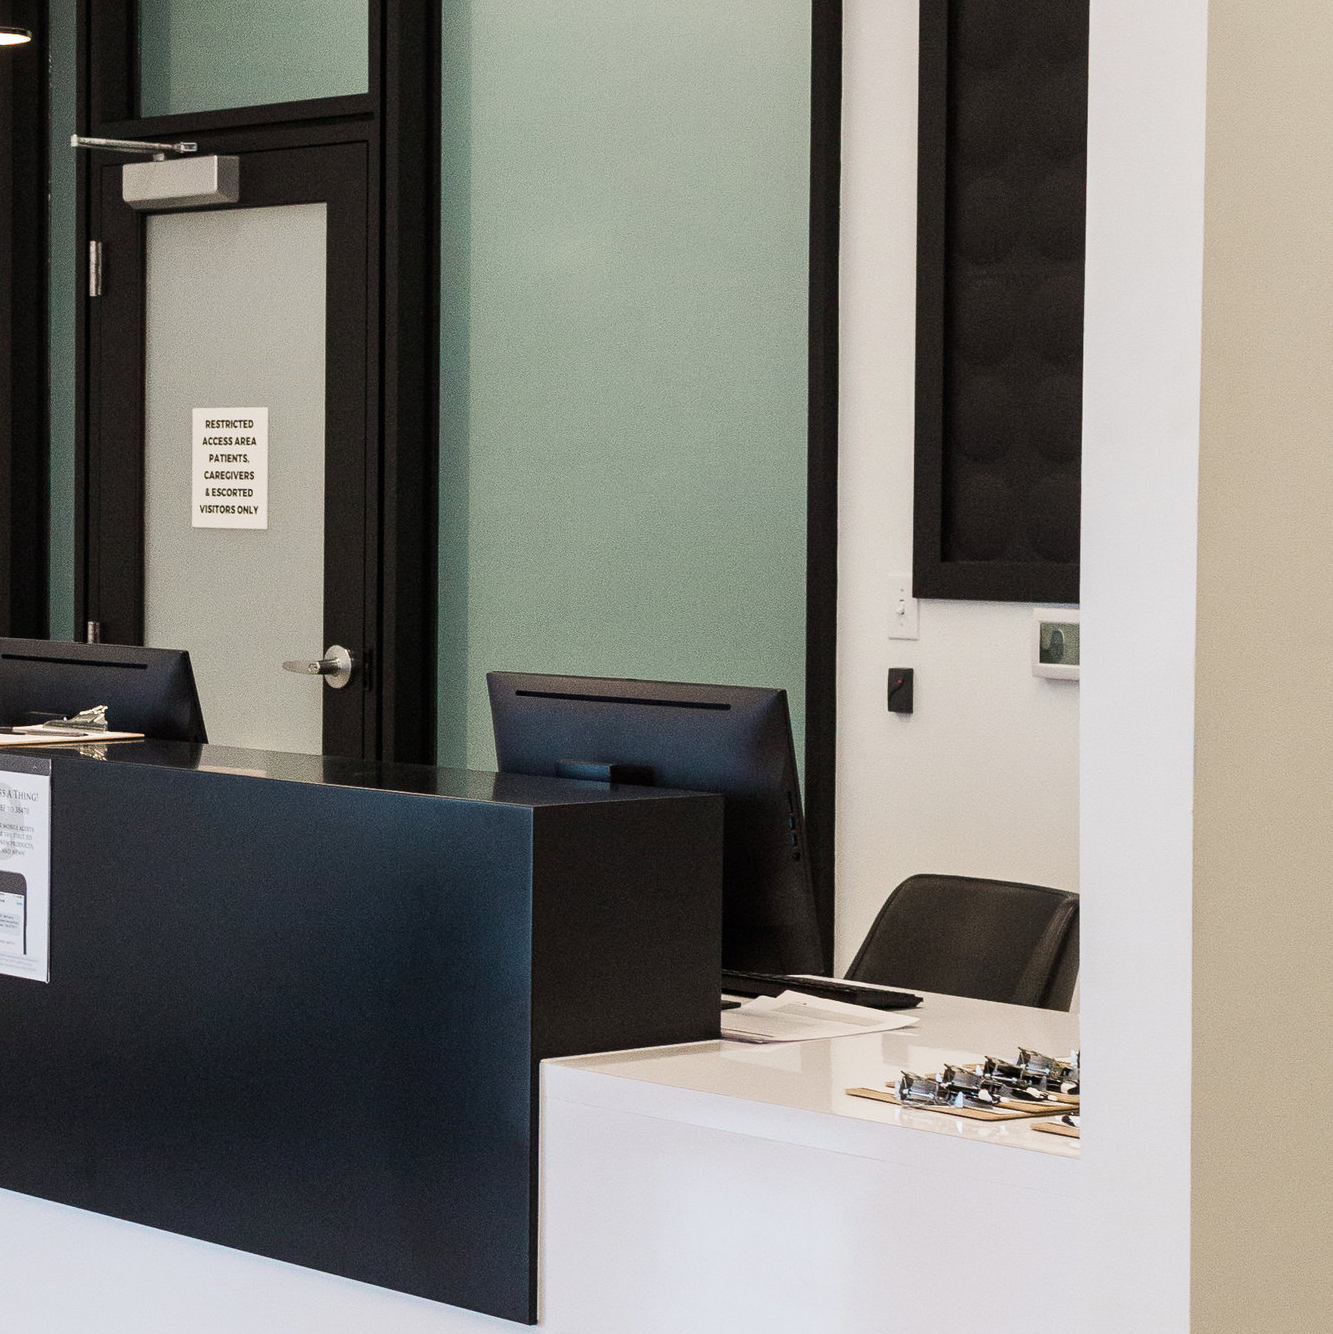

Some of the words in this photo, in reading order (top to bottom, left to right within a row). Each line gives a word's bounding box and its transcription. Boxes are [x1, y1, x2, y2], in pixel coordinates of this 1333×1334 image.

[205, 419, 254, 429] RESTRICTED
[202, 436, 233, 446] ACCESS
[234, 436, 257, 446] AREA
[208, 453, 250, 463] PATIENTS,
[203, 470, 255, 480] CAREGIVERS
[205, 488, 210, 497] &
[211, 488, 254, 497] ESCORTED
[199, 505, 236, 514] VISITORS
[237, 505, 259, 515] ONLY
[6, 788, 12, 798] A
[12, 789, 39, 802] THING!
